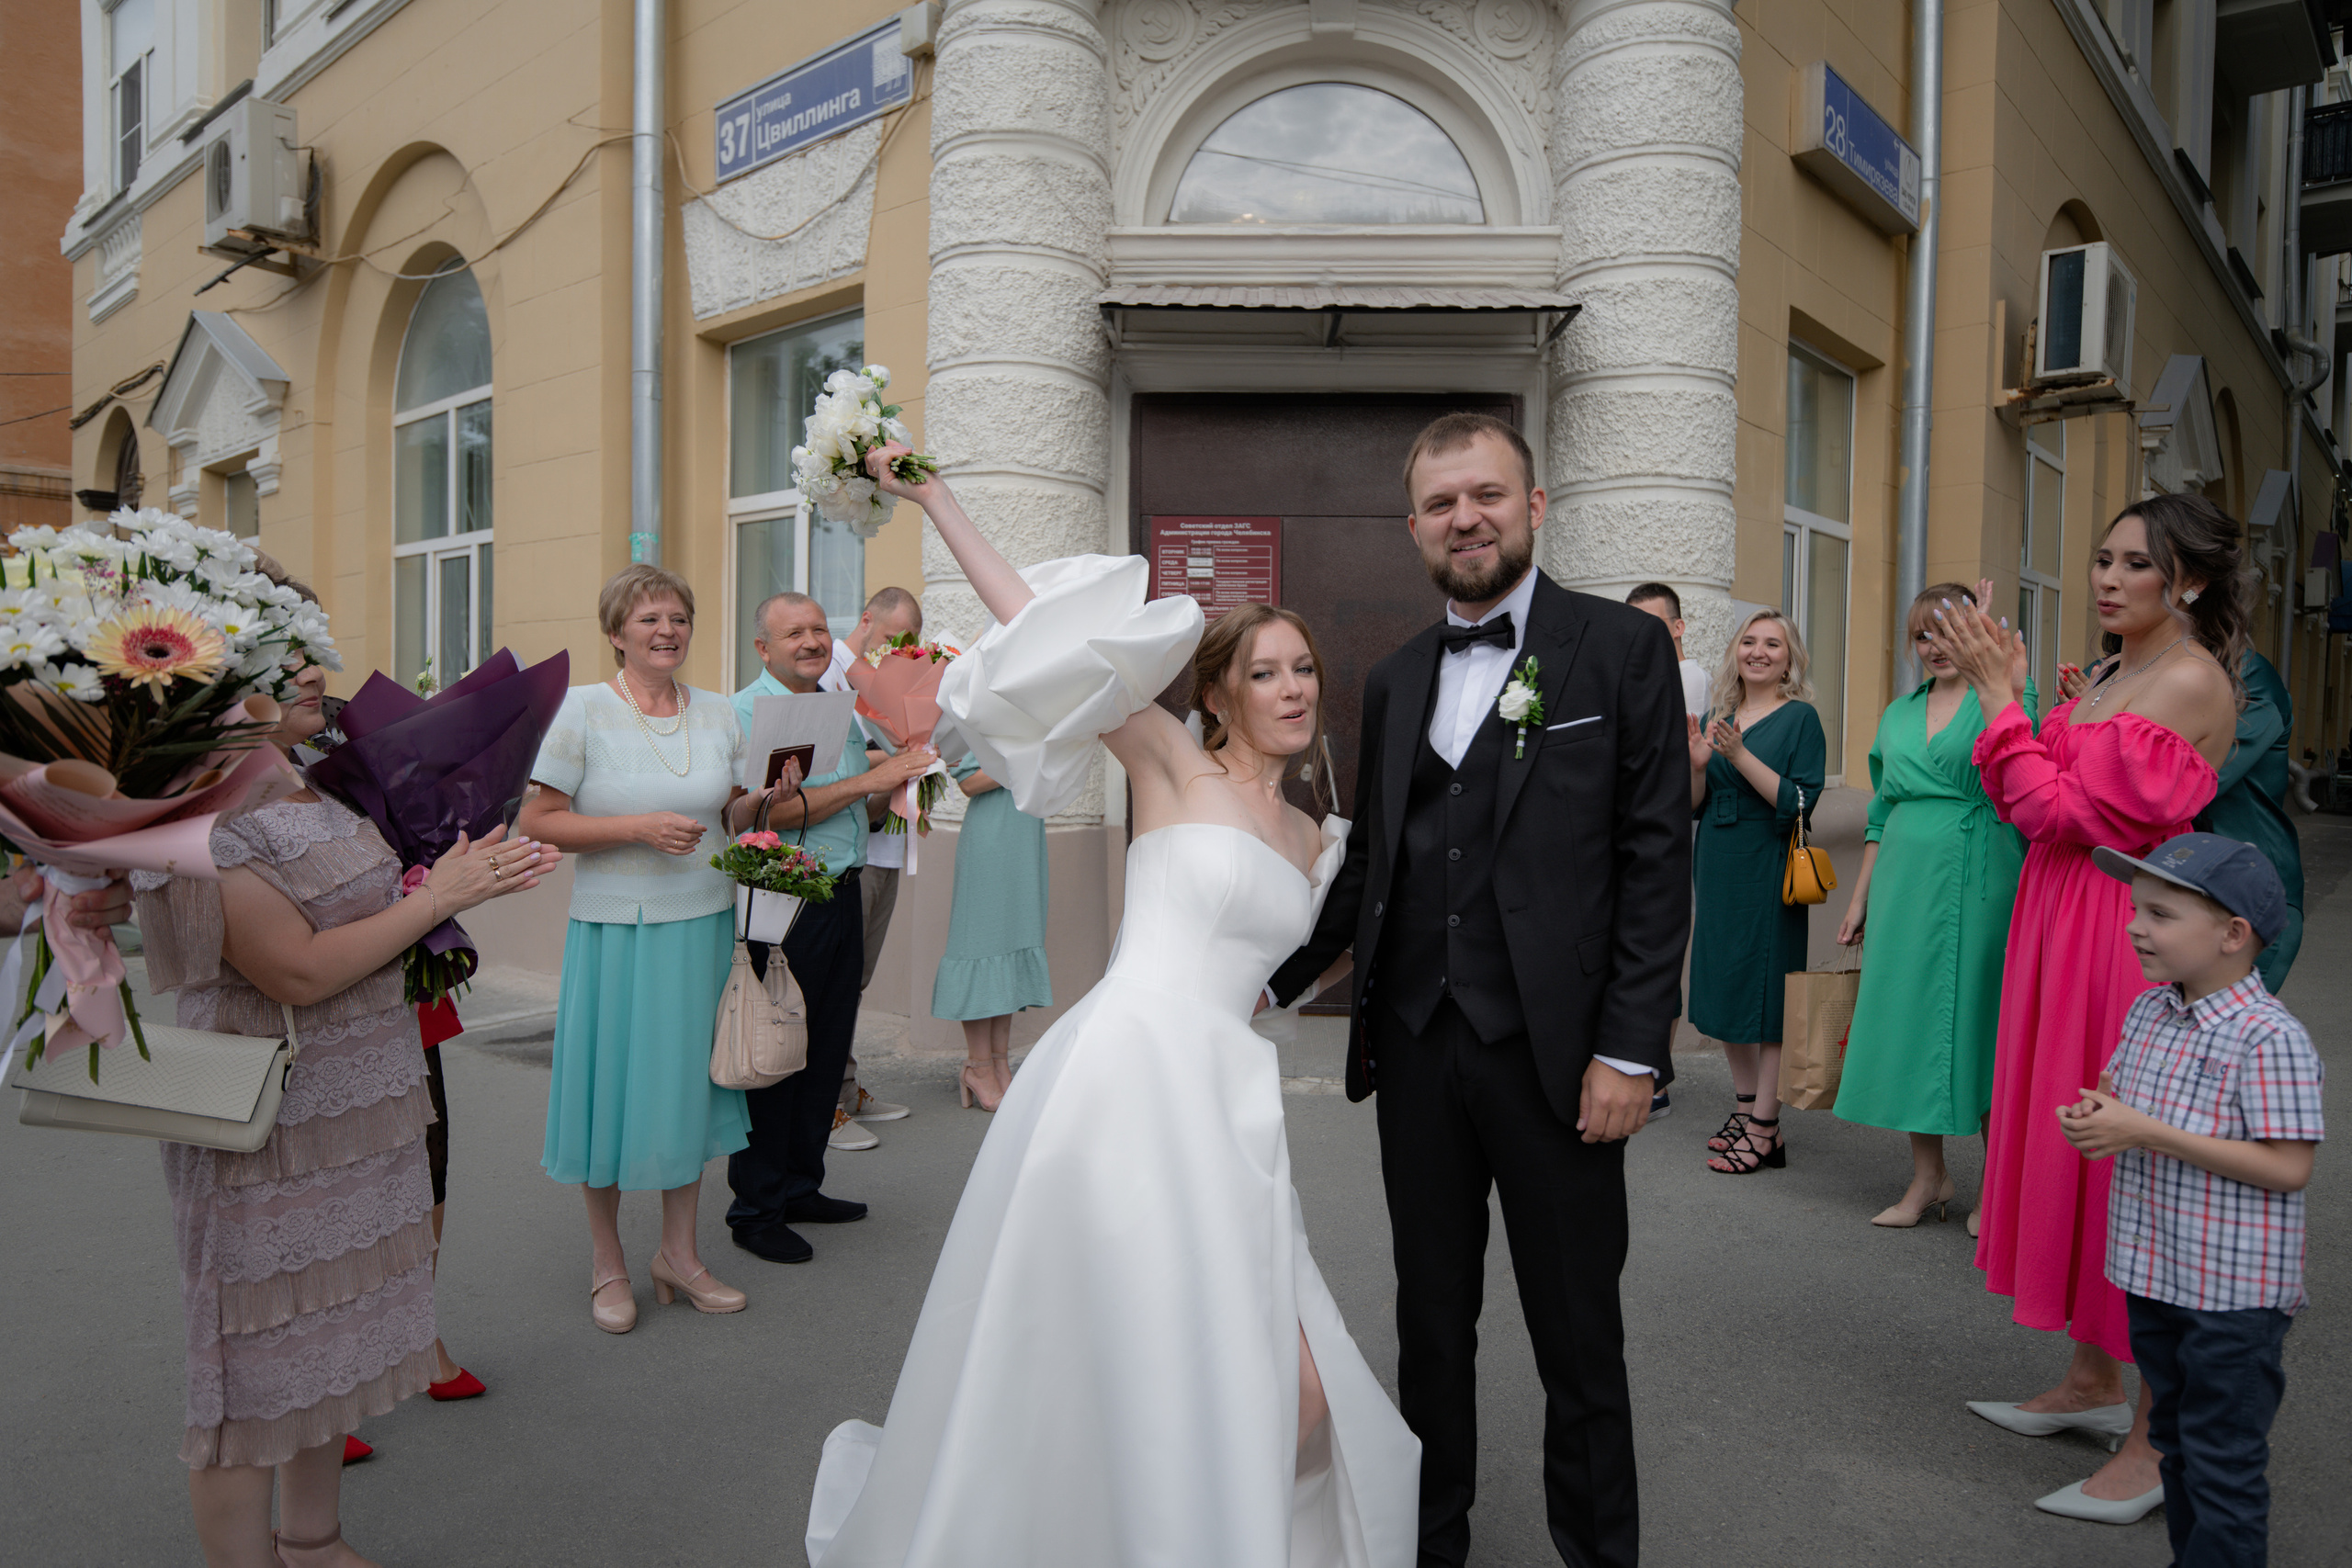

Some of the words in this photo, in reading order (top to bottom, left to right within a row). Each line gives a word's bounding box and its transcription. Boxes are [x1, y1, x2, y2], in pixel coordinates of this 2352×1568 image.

[756, 92, 792, 122] улица
[756, 87, 861, 151] Цвиллинга
[1826, 105, 1846, 158] 28
[719, 112, 751, 165] 37
[1848, 140, 1898, 203] Тимирязева
